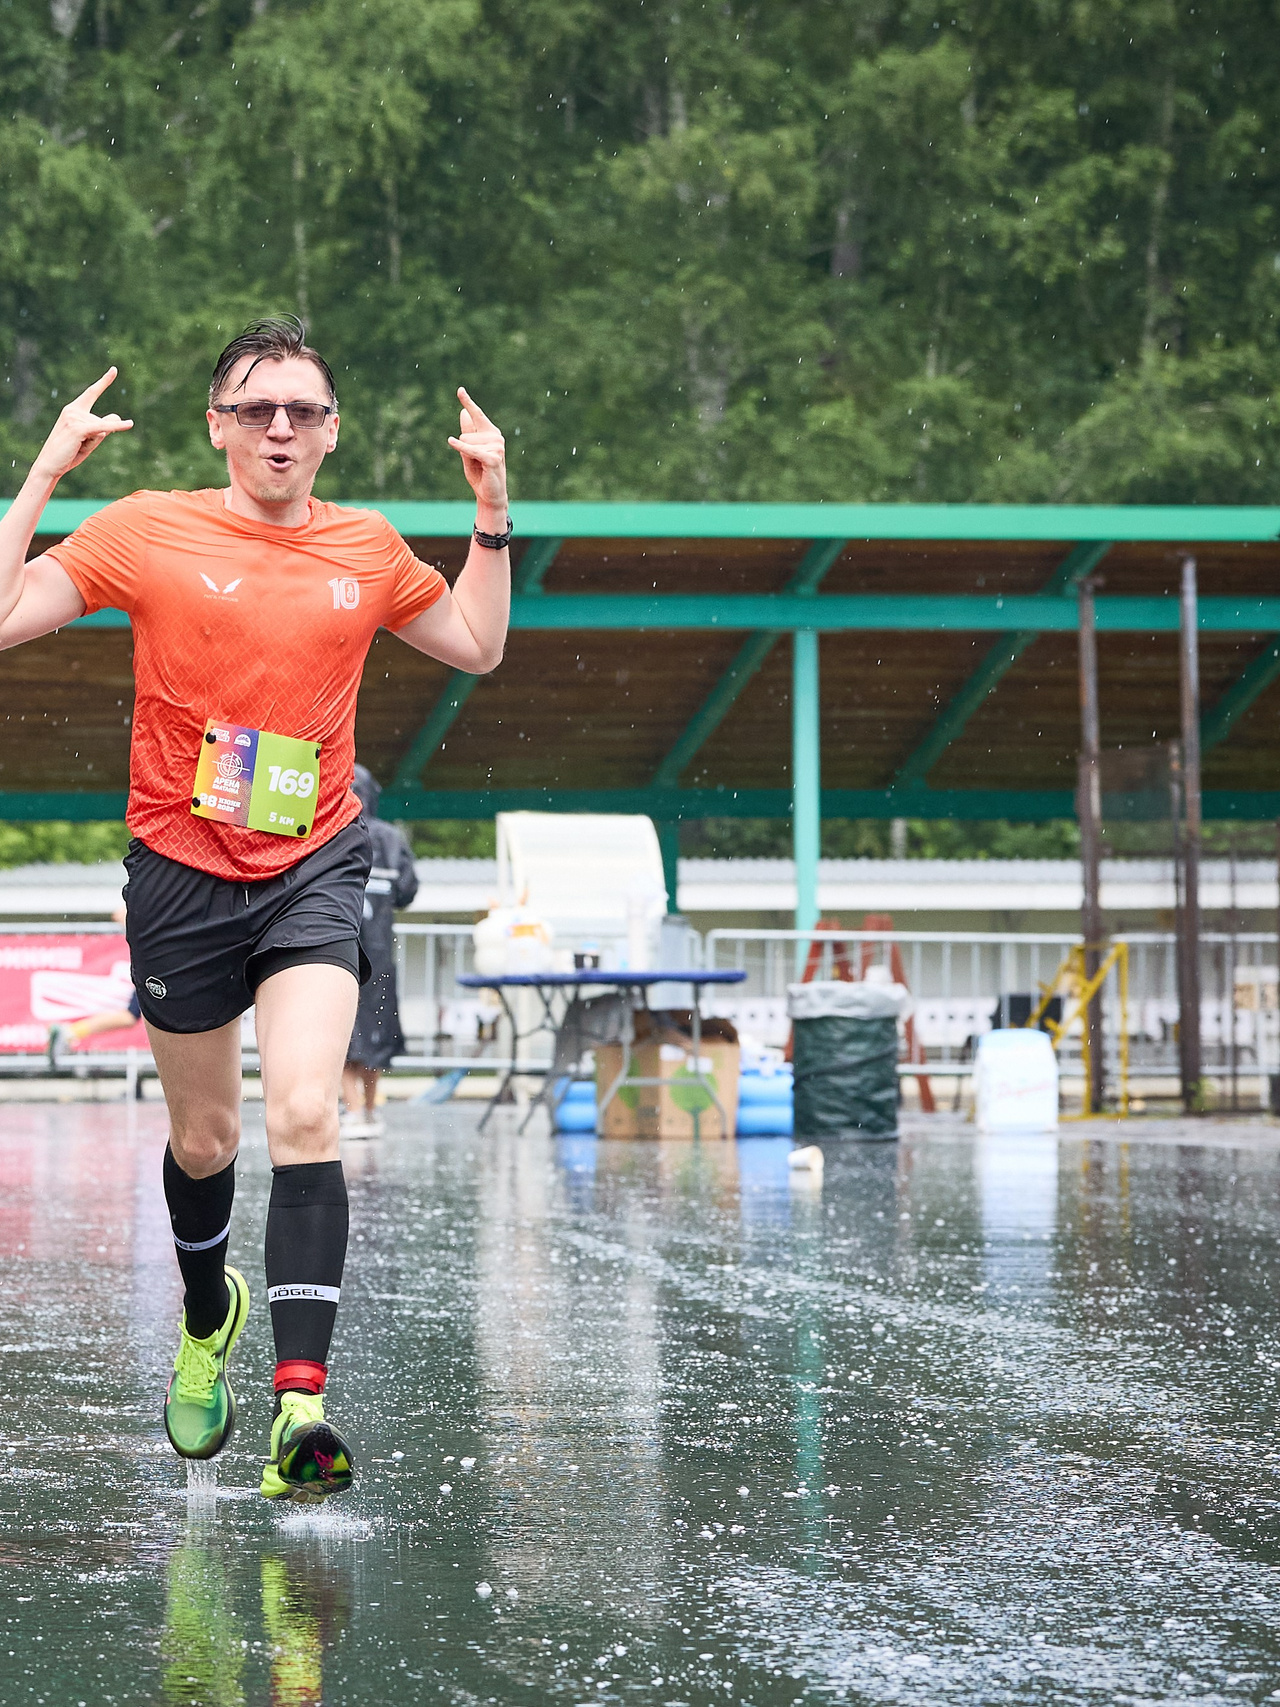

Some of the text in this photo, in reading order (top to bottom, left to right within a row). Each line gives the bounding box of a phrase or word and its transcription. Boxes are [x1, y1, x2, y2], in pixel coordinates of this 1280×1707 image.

[327, 577, 360, 610] 10
[213, 776, 240, 789] АРЕНА
[268, 765, 315, 798] 169
[268, 811, 278, 823] 5
[270, 1286, 325, 1298] JÖGEL
